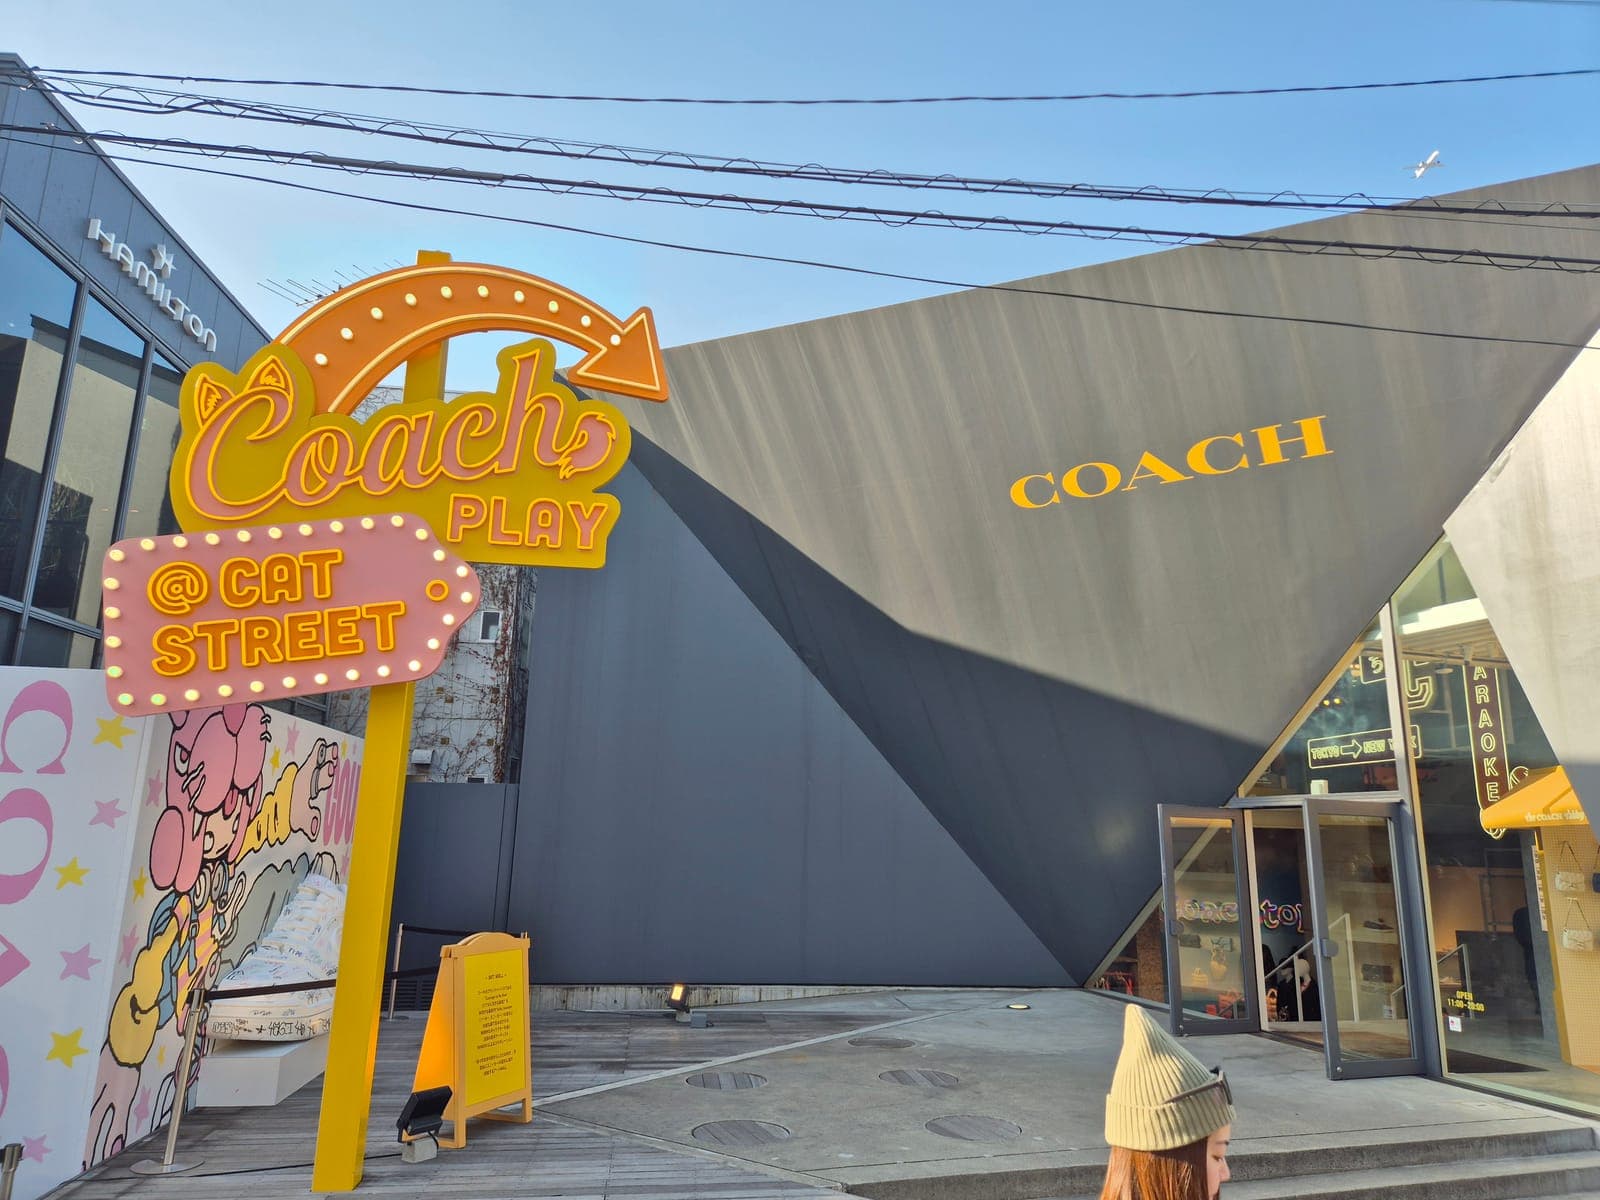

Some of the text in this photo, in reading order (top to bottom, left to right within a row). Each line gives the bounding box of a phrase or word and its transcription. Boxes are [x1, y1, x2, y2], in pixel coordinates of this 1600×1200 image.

[88, 218, 217, 352] HAMILTON
[184, 347, 617, 521] Coach
[1010, 415, 1334, 509] COACH
[446, 494, 609, 551] PLAY
[146, 548, 344, 616] @ CAT
[151, 600, 406, 677] STREET
[1363, 738, 1386, 754] NEW
[1456, 990, 1473, 1001] OPEN
